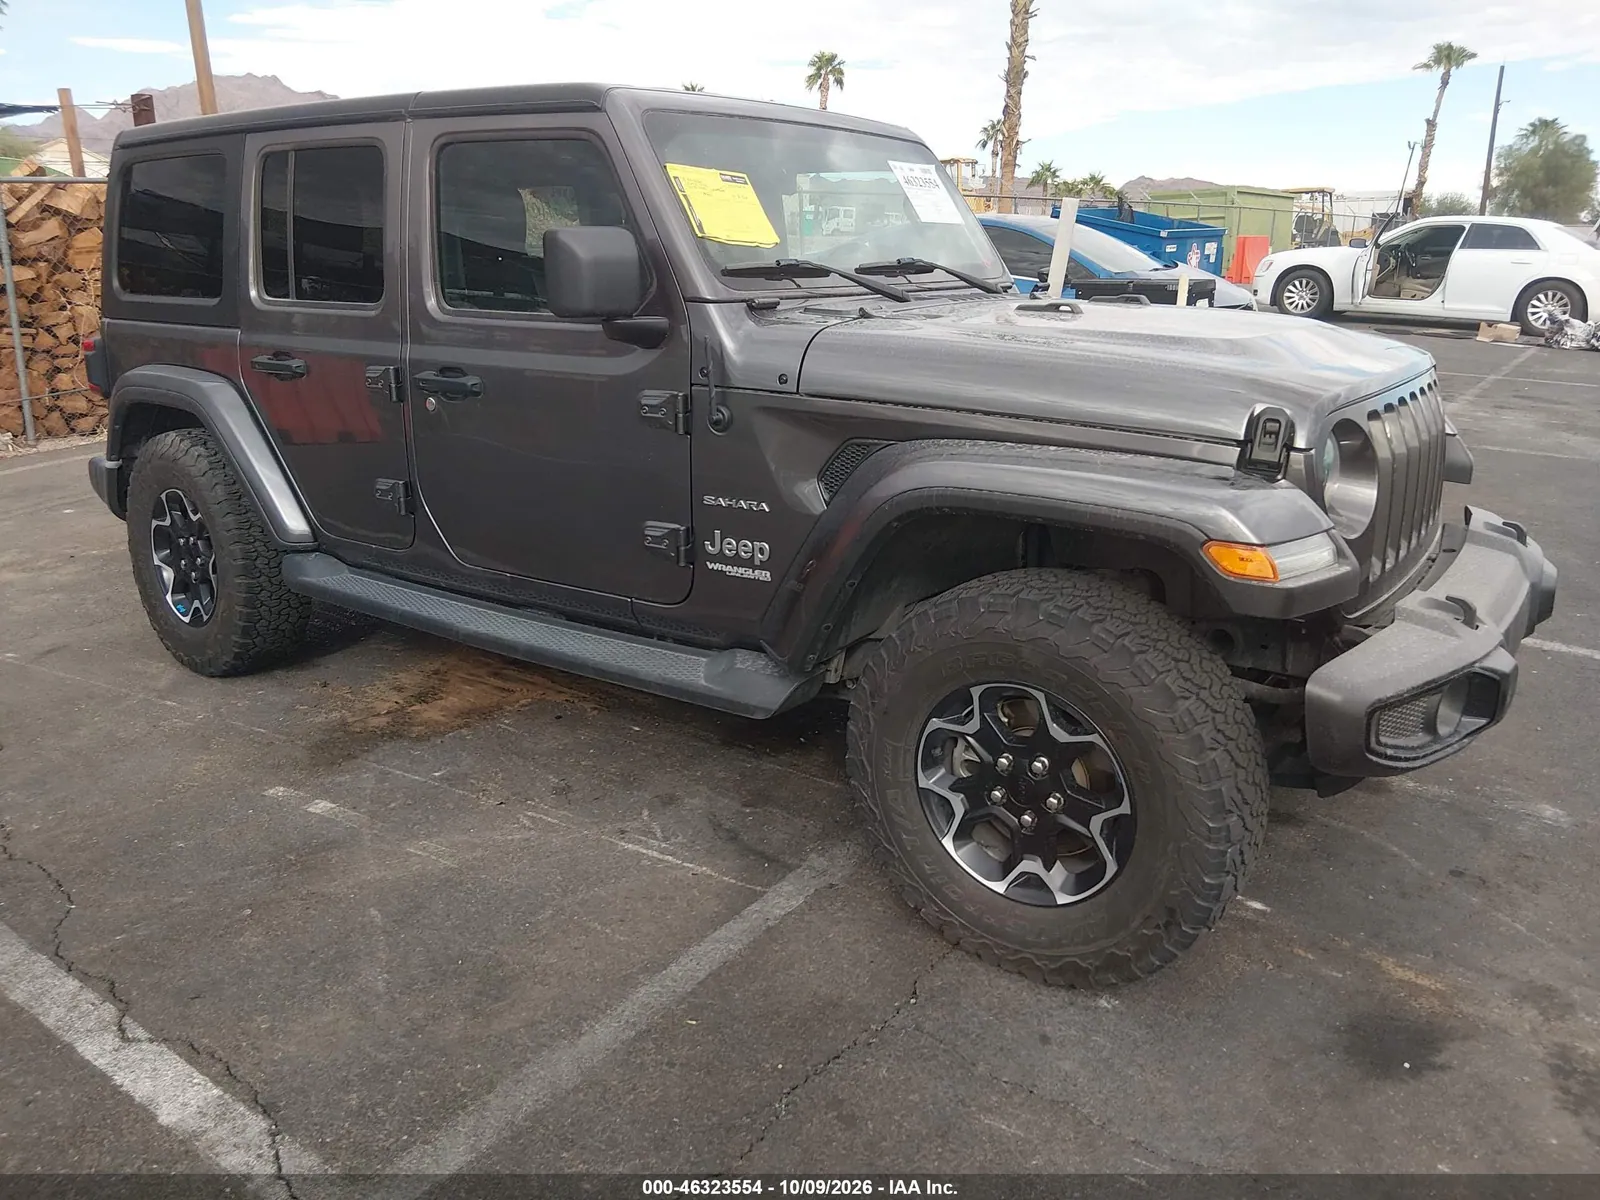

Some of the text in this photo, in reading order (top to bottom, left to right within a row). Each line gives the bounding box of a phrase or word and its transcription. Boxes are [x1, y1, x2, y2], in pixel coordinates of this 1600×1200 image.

[903, 175, 941, 189] 46323554
[703, 495, 770, 512] SAHARA
[704, 530, 770, 566] Jeep
[706, 561, 771, 578] WRANGLER
